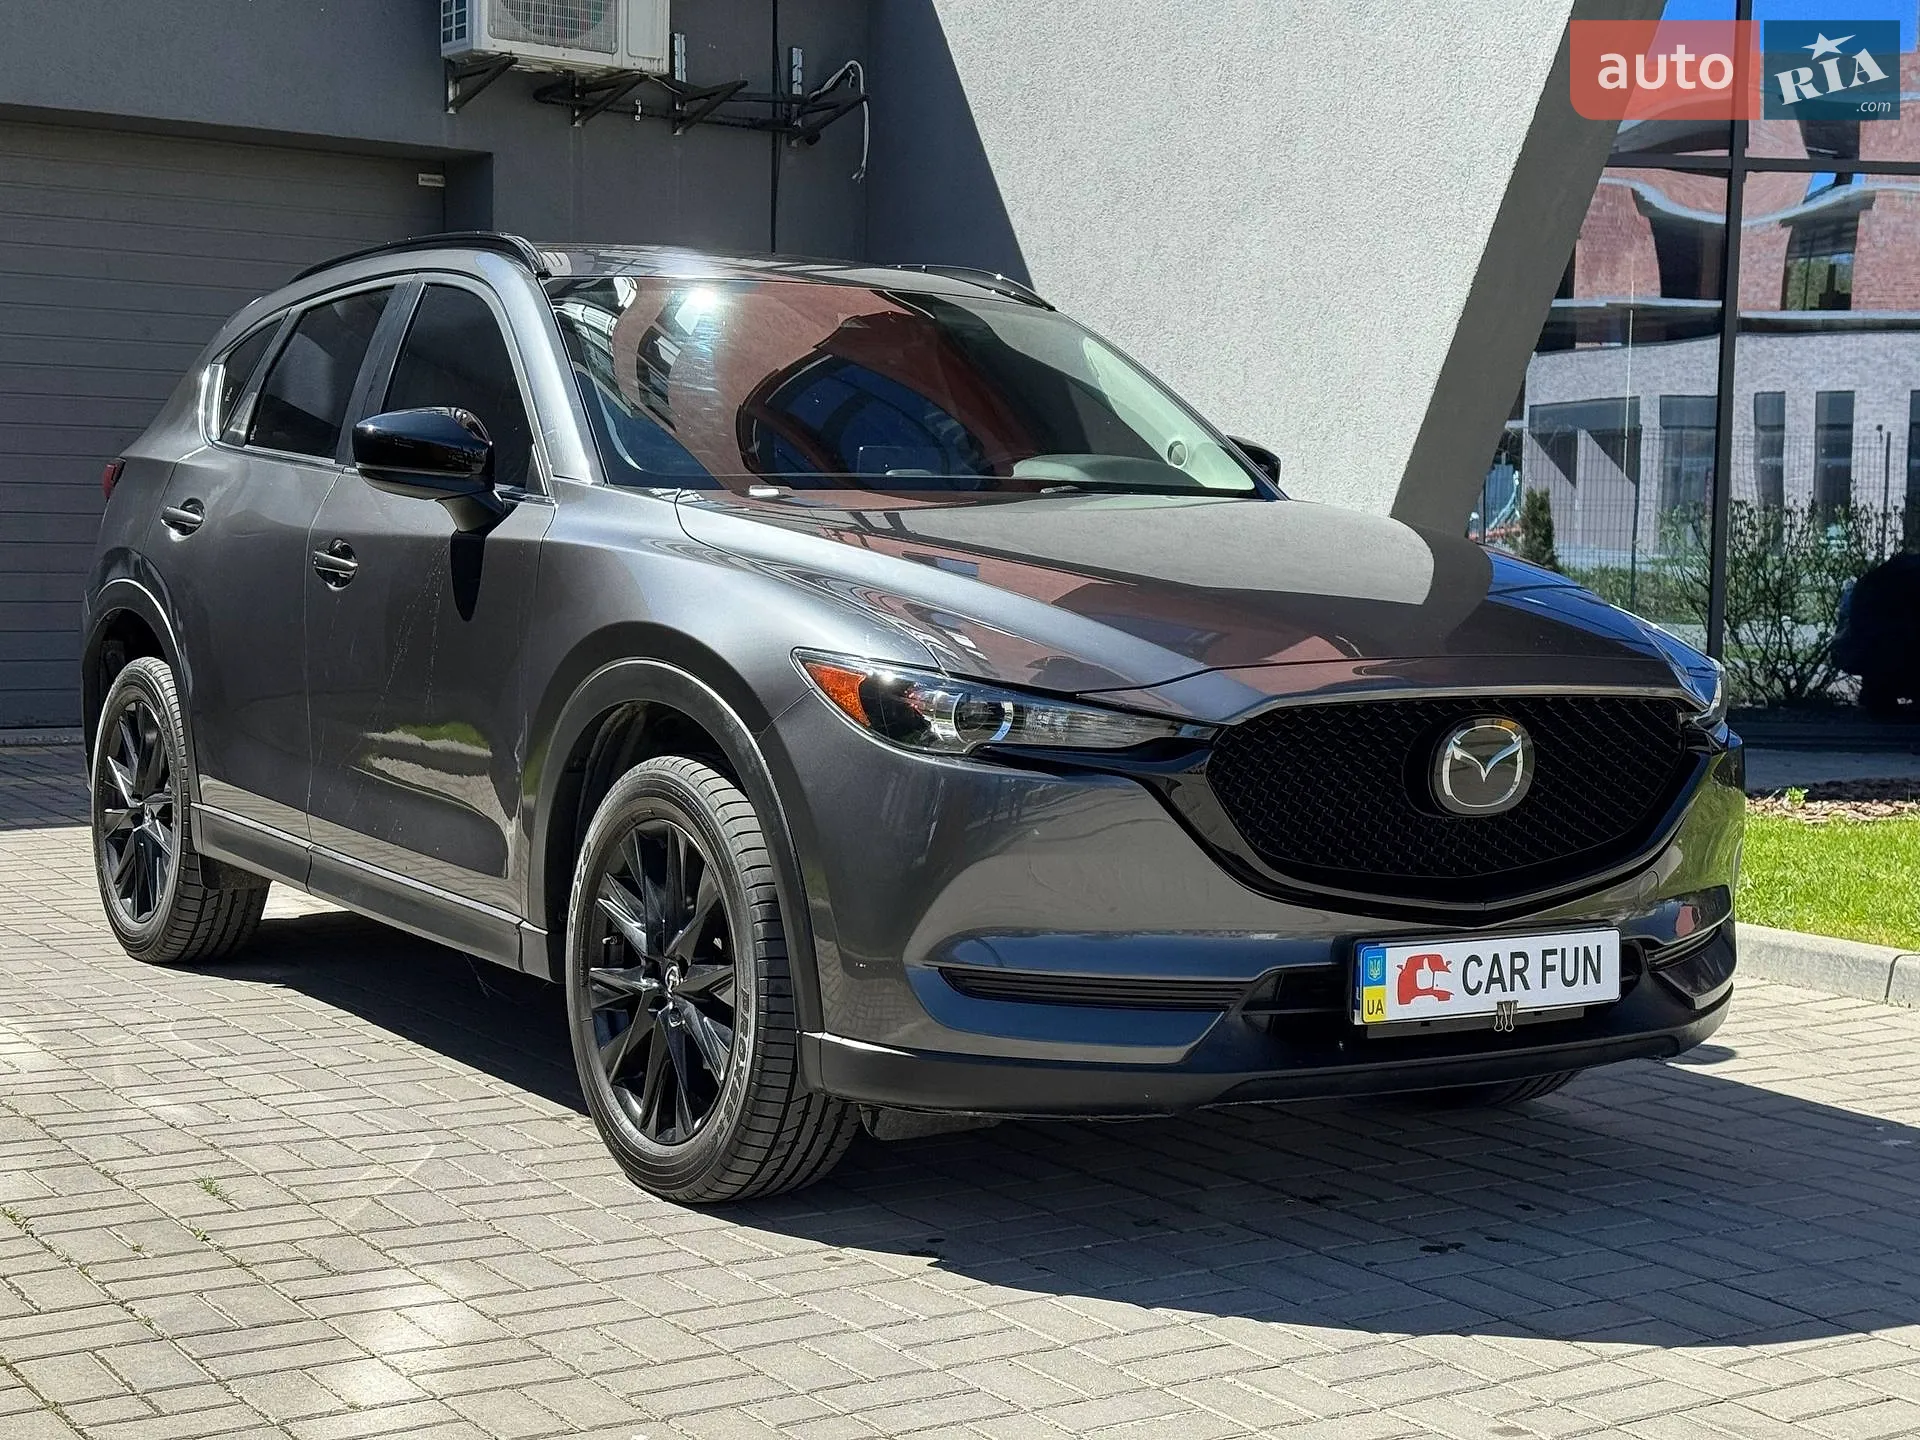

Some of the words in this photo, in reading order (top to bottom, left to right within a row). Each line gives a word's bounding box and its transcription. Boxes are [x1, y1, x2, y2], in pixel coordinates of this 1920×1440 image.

[1462, 951, 1530, 996] CAR
[1541, 945, 1602, 989] FUN
[1367, 998, 1385, 1016] UA
